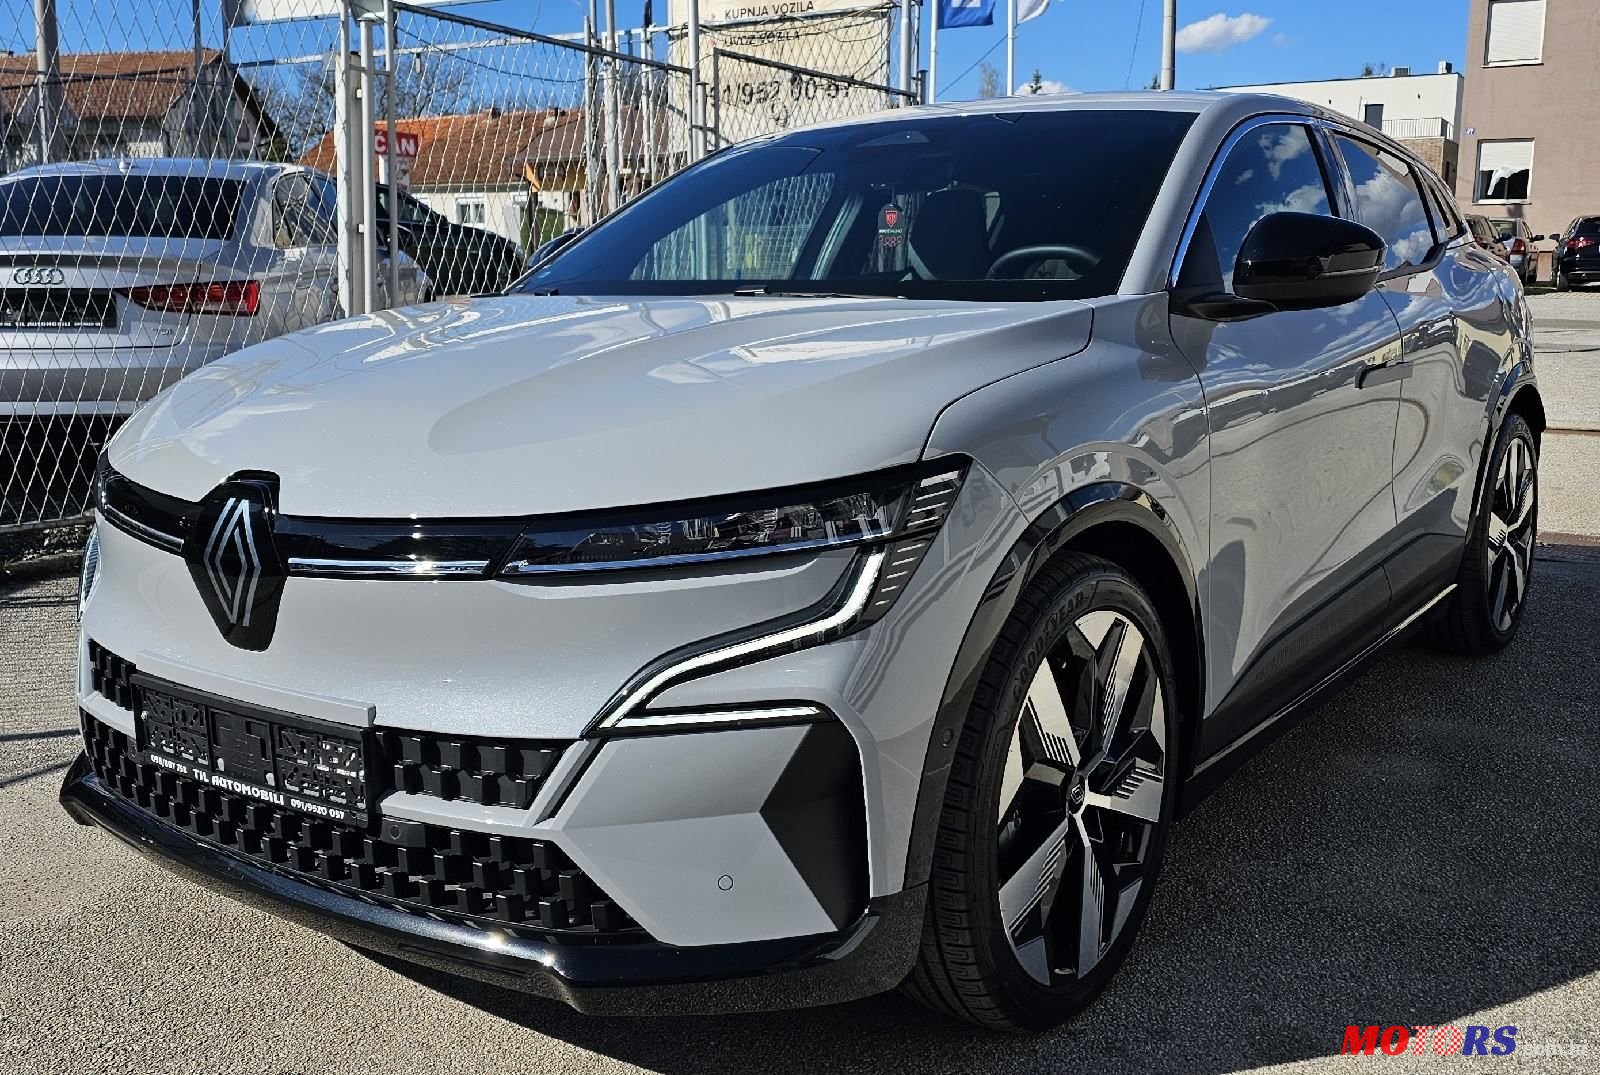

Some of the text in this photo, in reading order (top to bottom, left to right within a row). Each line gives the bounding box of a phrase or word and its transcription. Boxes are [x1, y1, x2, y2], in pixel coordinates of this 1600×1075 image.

[724, 0, 814, 19] KUPNJA VOZILA
[1012, 590, 1087, 700] GOODYEAR
[193, 768, 210, 783] TIL
[211, 775, 285, 806] AUTOMOBILI
